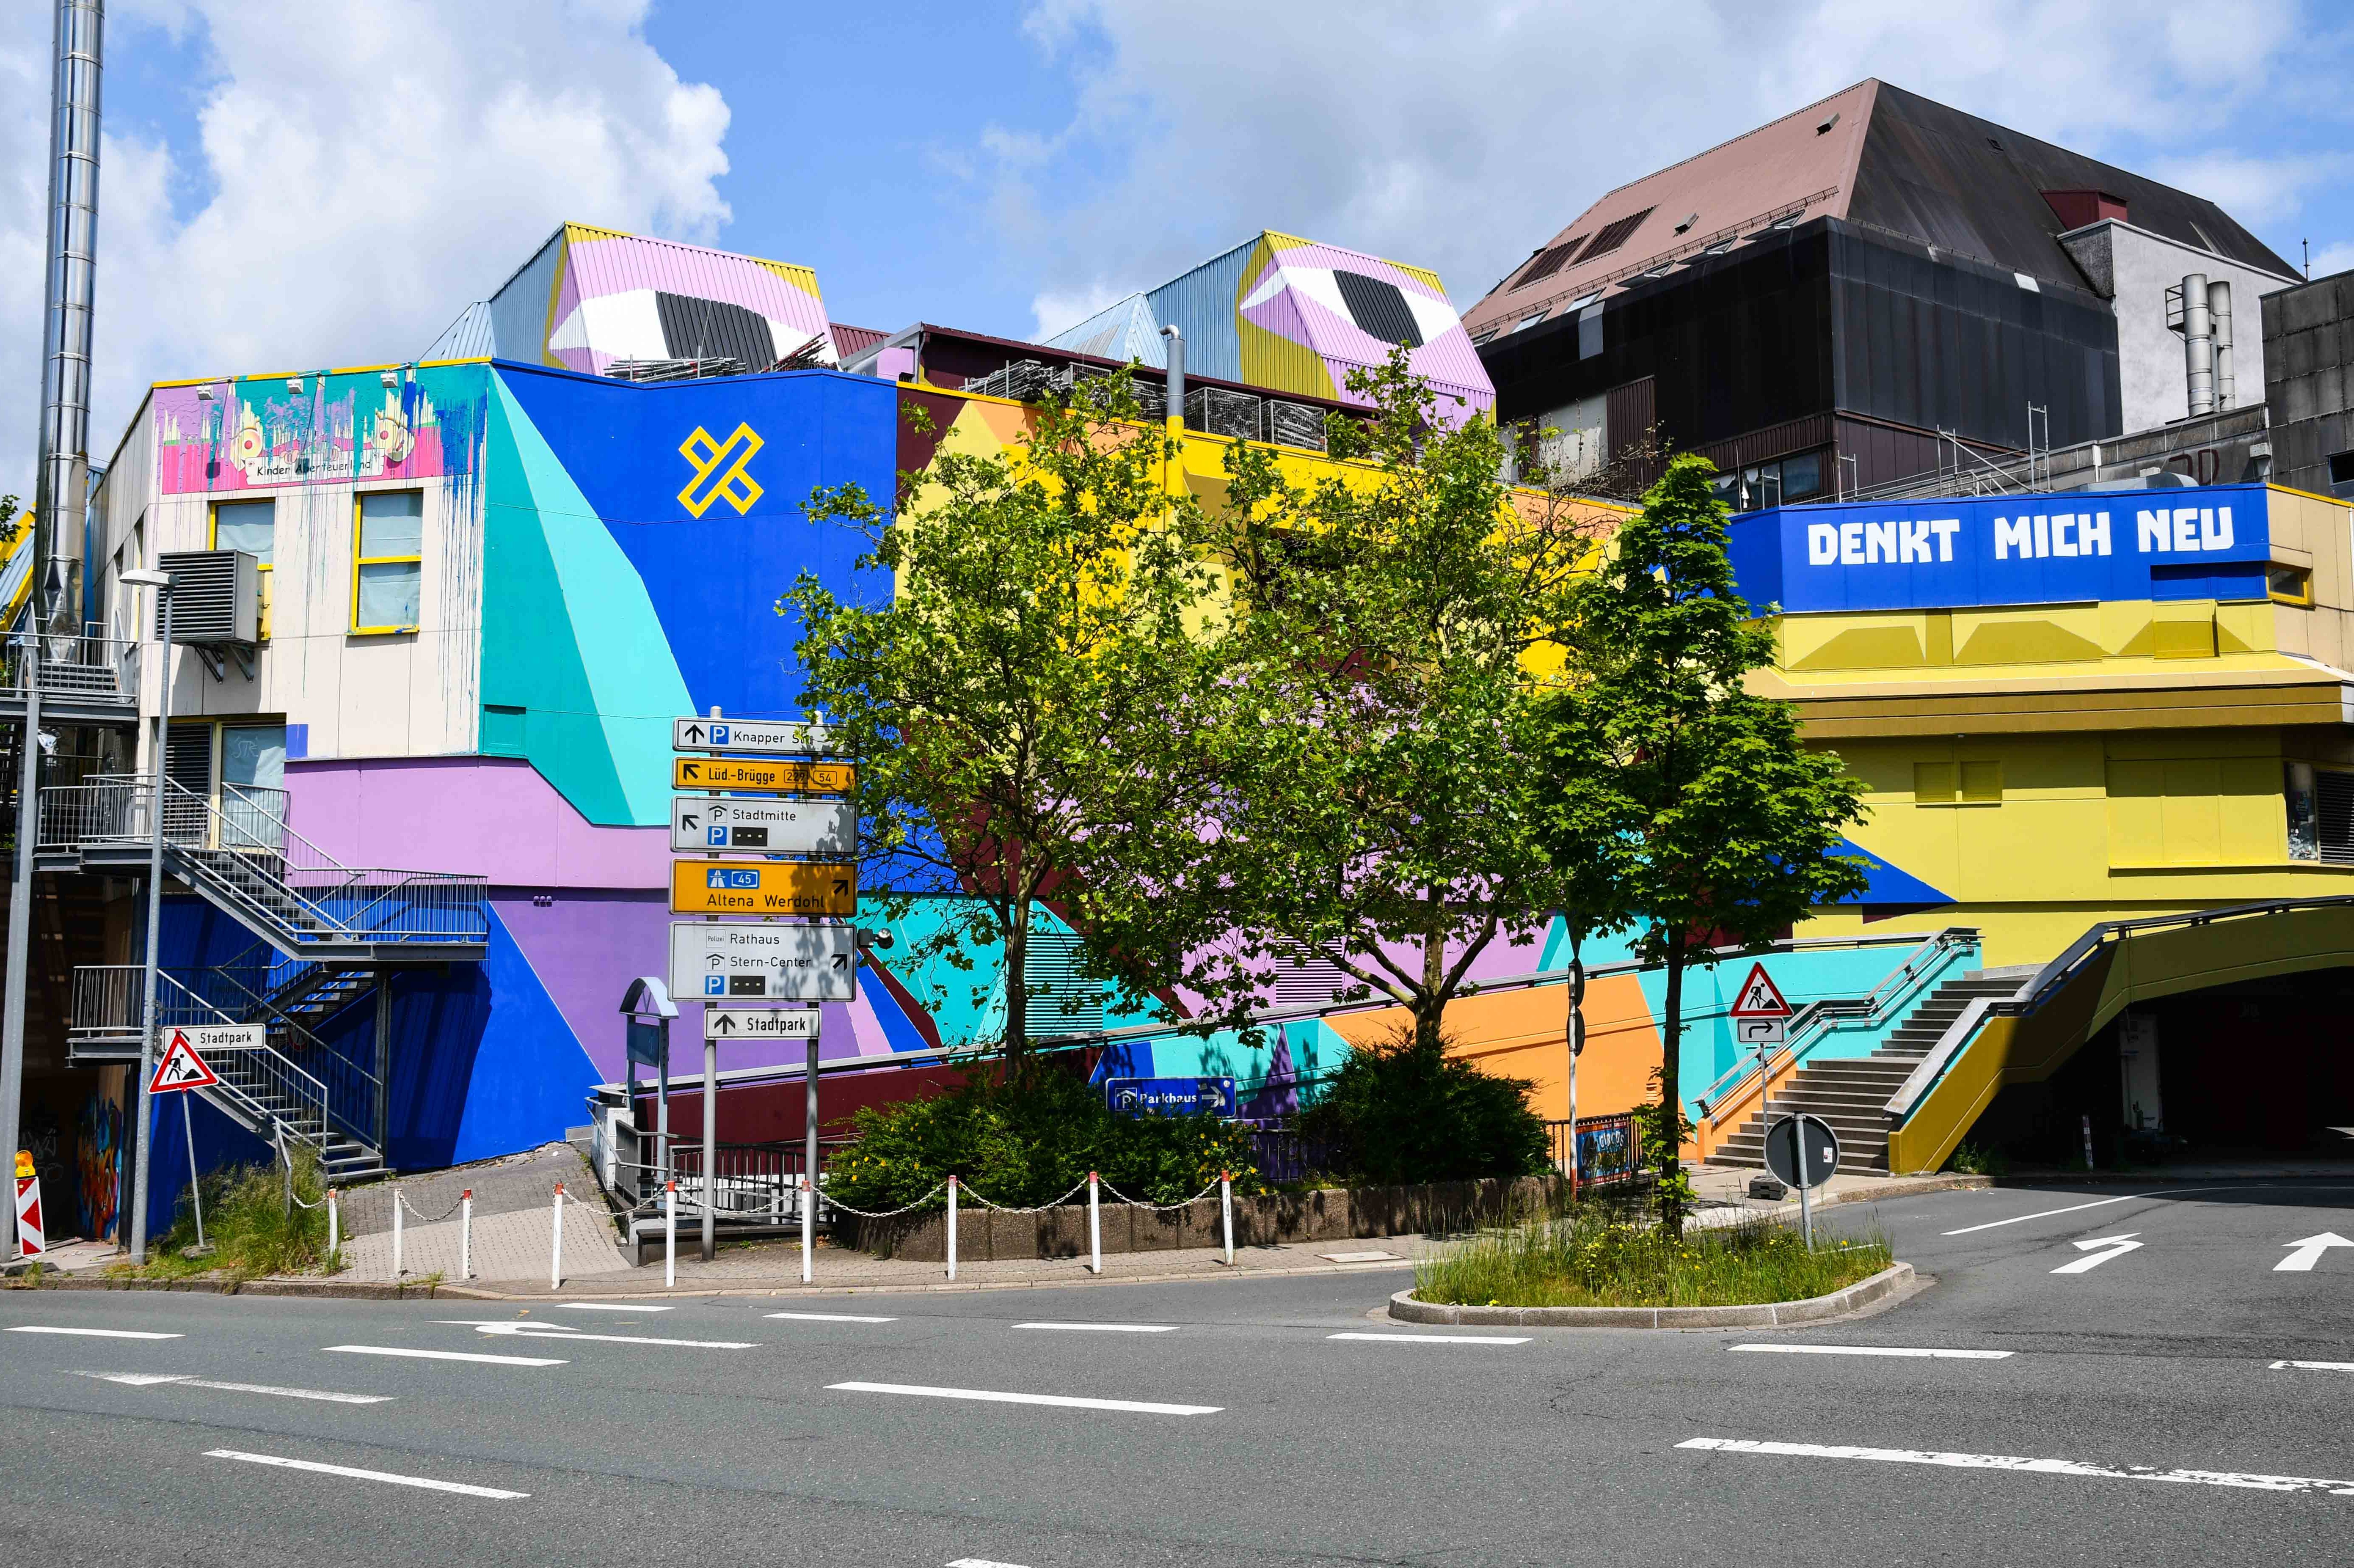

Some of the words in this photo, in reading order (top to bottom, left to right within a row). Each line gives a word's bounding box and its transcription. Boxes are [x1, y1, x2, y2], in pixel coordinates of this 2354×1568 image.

[257, 465, 291, 476] Kinder
[1808, 518, 1960, 566] DENKT
[1993, 512, 2111, 560] MICH
[2137, 506, 2235, 553] NEU
[734, 731, 785, 745] Knapper
[708, 767, 775, 784] Lüd.-Brügge
[787, 773, 804, 782] 229
[819, 773, 831, 782] 54
[733, 809, 796, 821] Stadtmitte
[738, 875, 751, 884] 45
[707, 894, 754, 907] Altena
[765, 894, 824, 908] Werdohl
[730, 933, 780, 944] Rathaus
[730, 957, 811, 967] Stern-Center
[747, 1018, 806, 1034] Stadtpark
[200, 1032, 252, 1045] Stadtpark
[1140, 1093, 1197, 1104] Parkhaus
